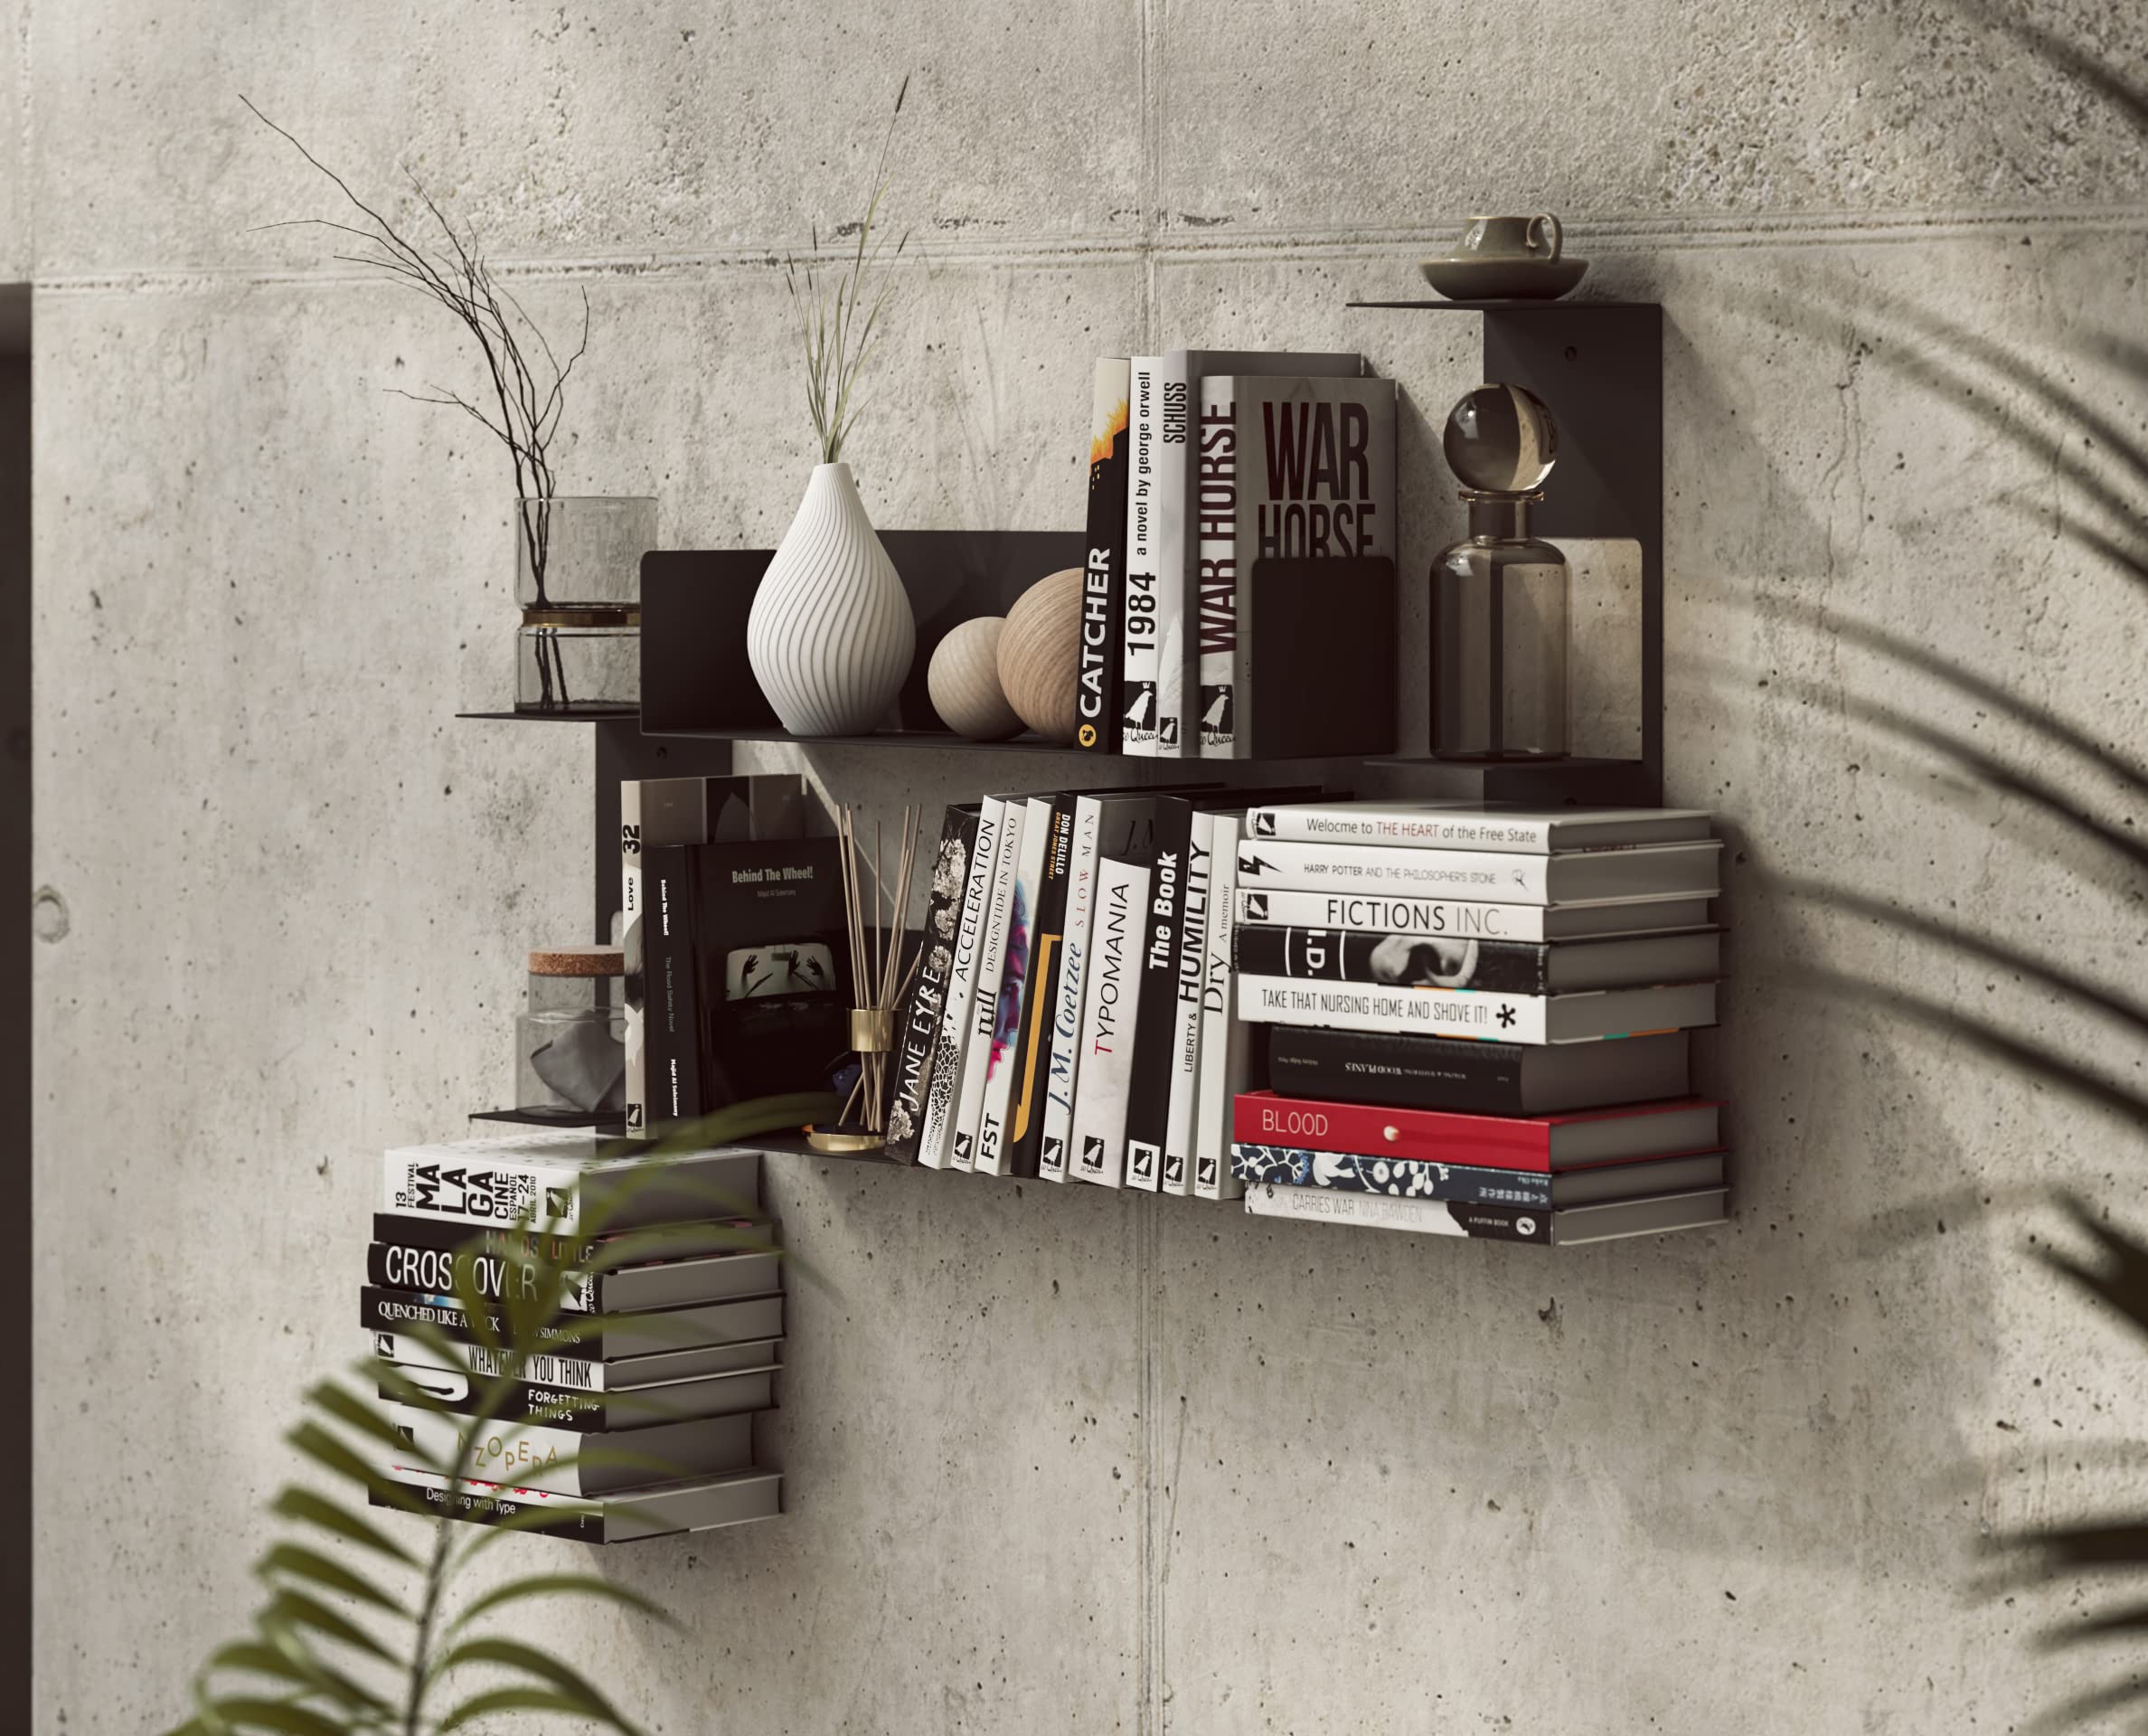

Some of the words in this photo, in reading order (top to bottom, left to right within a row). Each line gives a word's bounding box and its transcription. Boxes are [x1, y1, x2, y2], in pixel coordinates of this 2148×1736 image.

[1138, 372, 1151, 418] orwell
[1164, 382, 1186, 444] SCHUSS
[1138, 422, 1152, 475] george
[1262, 401, 1371, 501] WAR
[1136, 478, 1151, 497] by
[1200, 401, 1237, 542] HORSE
[1136, 502, 1148, 542] novel
[1136, 547, 1147, 556] a
[1127, 571, 1156, 656] 1984
[1200, 558, 1238, 655] WAR
[1079, 546, 1110, 718] CATCHER
[622, 824, 640, 854] 32
[1003, 817, 1017, 868] TOKYO
[1060, 814, 1070, 835] DON
[1361, 822, 1372, 834] to
[1376, 822, 1398, 835] THE
[1401, 824, 1440, 838] HEART
[1442, 824, 1456, 839] of
[1457, 825, 1476, 840] the
[1479, 826, 1504, 842] Free
[1507, 828, 1537, 843] State
[731, 869, 763, 883] Behind
[765, 868, 781, 882] The
[782, 865, 814, 880] Wheel!
[1055, 836, 1069, 874] DELILLO
[1075, 870, 1089, 927] SLOW
[1082, 814, 1095, 857] MAN
[1304, 863, 1328, 875] HARRY
[1332, 864, 1362, 876] POTTER
[1366, 867, 1382, 878] AND
[1386, 868, 1400, 879] THE
[1470, 872, 1495, 884] STONE
[626, 876, 635, 911] Love
[956, 819, 996, 982] ACCELERATION
[999, 872, 1009, 886] IN
[1154, 852, 1178, 917] Book
[1178, 840, 1211, 1004] HUMILITY
[1220, 883, 1230, 929] memoir
[1327, 899, 1446, 930] FICTIONS
[1456, 907, 1508, 935] INC.
[985, 890, 1006, 972] DESIGNTIDE
[1149, 925, 1172, 970] The
[1219, 931, 1228, 942] A
[664, 956, 673, 969] The
[1094, 882, 1130, 1055] TYPOMANIA
[1204, 952, 1231, 1017] Dry
[912, 966, 941, 1035] EYRE
[1055, 943, 1082, 1038] Coetzee
[1262, 988, 1287, 1009] TAKE
[1291, 991, 1316, 1011] THAT
[1321, 993, 1369, 1015] NURSING
[1373, 997, 1403, 1018] HOME
[1408, 999, 1429, 1020] AND
[1434, 1002, 1470, 1024] SHOVE
[1474, 1005, 1487, 1024] IT!
[1188, 1012, 1197, 1021] &
[1183, 1023, 1197, 1072] LIBERTY
[899, 1041, 926, 1112] JANE
[981, 1113, 1000, 1160] FST
[1262, 1109, 1328, 1137] BLOOD
[395, 1192, 407, 1208] 13
[441, 1168, 466, 1214] LA
[467, 1171, 494, 1217] GA
[495, 1172, 508, 1220] CINE
[1333, 1196, 1354, 1215] WAR
[378, 1301, 435, 1321] QUENCHED
[438, 1308, 457, 1326] LIKE
[459, 1313, 467, 1327] A
[540, 1326, 580, 1344] SIMMONS
[533, 1355, 554, 1382] YOU
[559, 1359, 592, 1389] THINK
[528, 1389, 600, 1411] FORGETTING
[528, 1403, 573, 1421] THINGS
[427, 1488, 471, 1510] Desiging
[474, 1496, 494, 1511] with
[495, 1499, 516, 1515] Type
